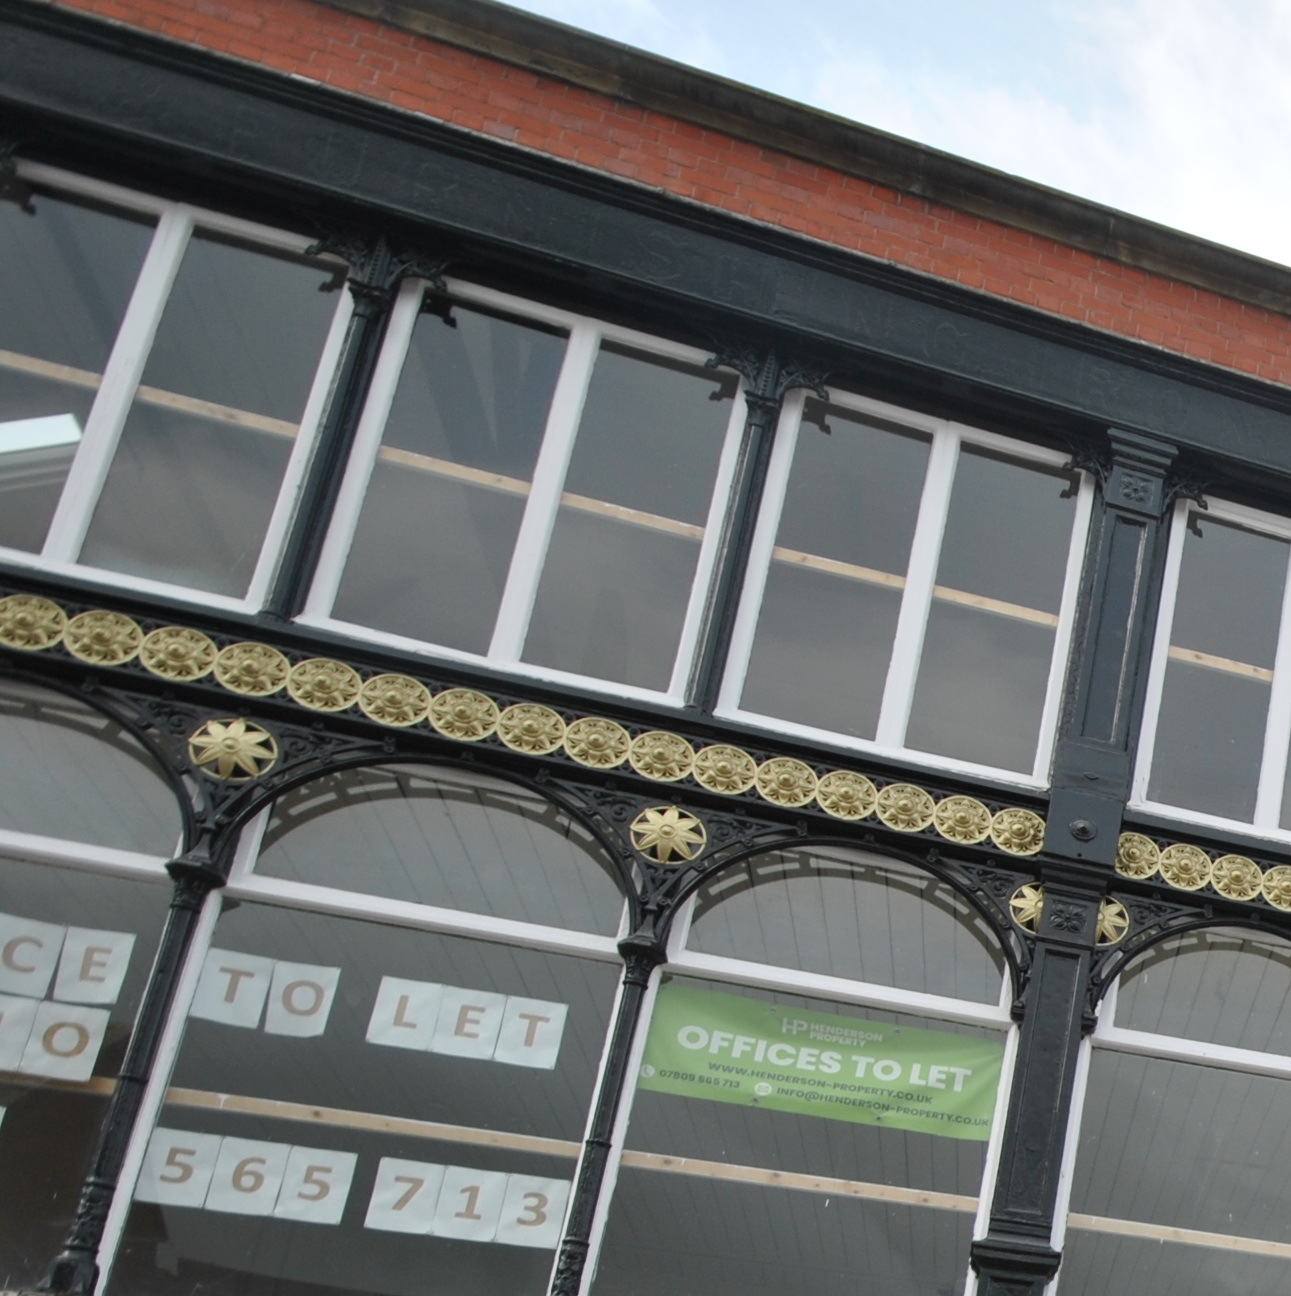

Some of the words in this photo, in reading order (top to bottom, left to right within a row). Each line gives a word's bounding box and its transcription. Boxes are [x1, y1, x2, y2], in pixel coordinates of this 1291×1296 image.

[218, 966, 326, 1017] TO
[392, 994, 551, 1048] LET
[809, 1021, 884, 1043] HENDERSON
[809, 1032, 868, 1048] PROPERTY
[658, 1069, 696, 1083] 07809
[722, 1079, 741, 1089] 713
[676, 1025, 843, 1074] OFFICES
[850, 1054, 902, 1082] TO
[908, 1062, 973, 1093] LET
[708, 1061, 933, 1105] WWW.HENDERSON-PROPERTY.CO.UK
[776, 1086, 990, 1127] INFO@HENDERSON-PROPERTY.CO.UK
[159, 1146, 333, 1203] 565
[390, 1175, 549, 1228] 713
